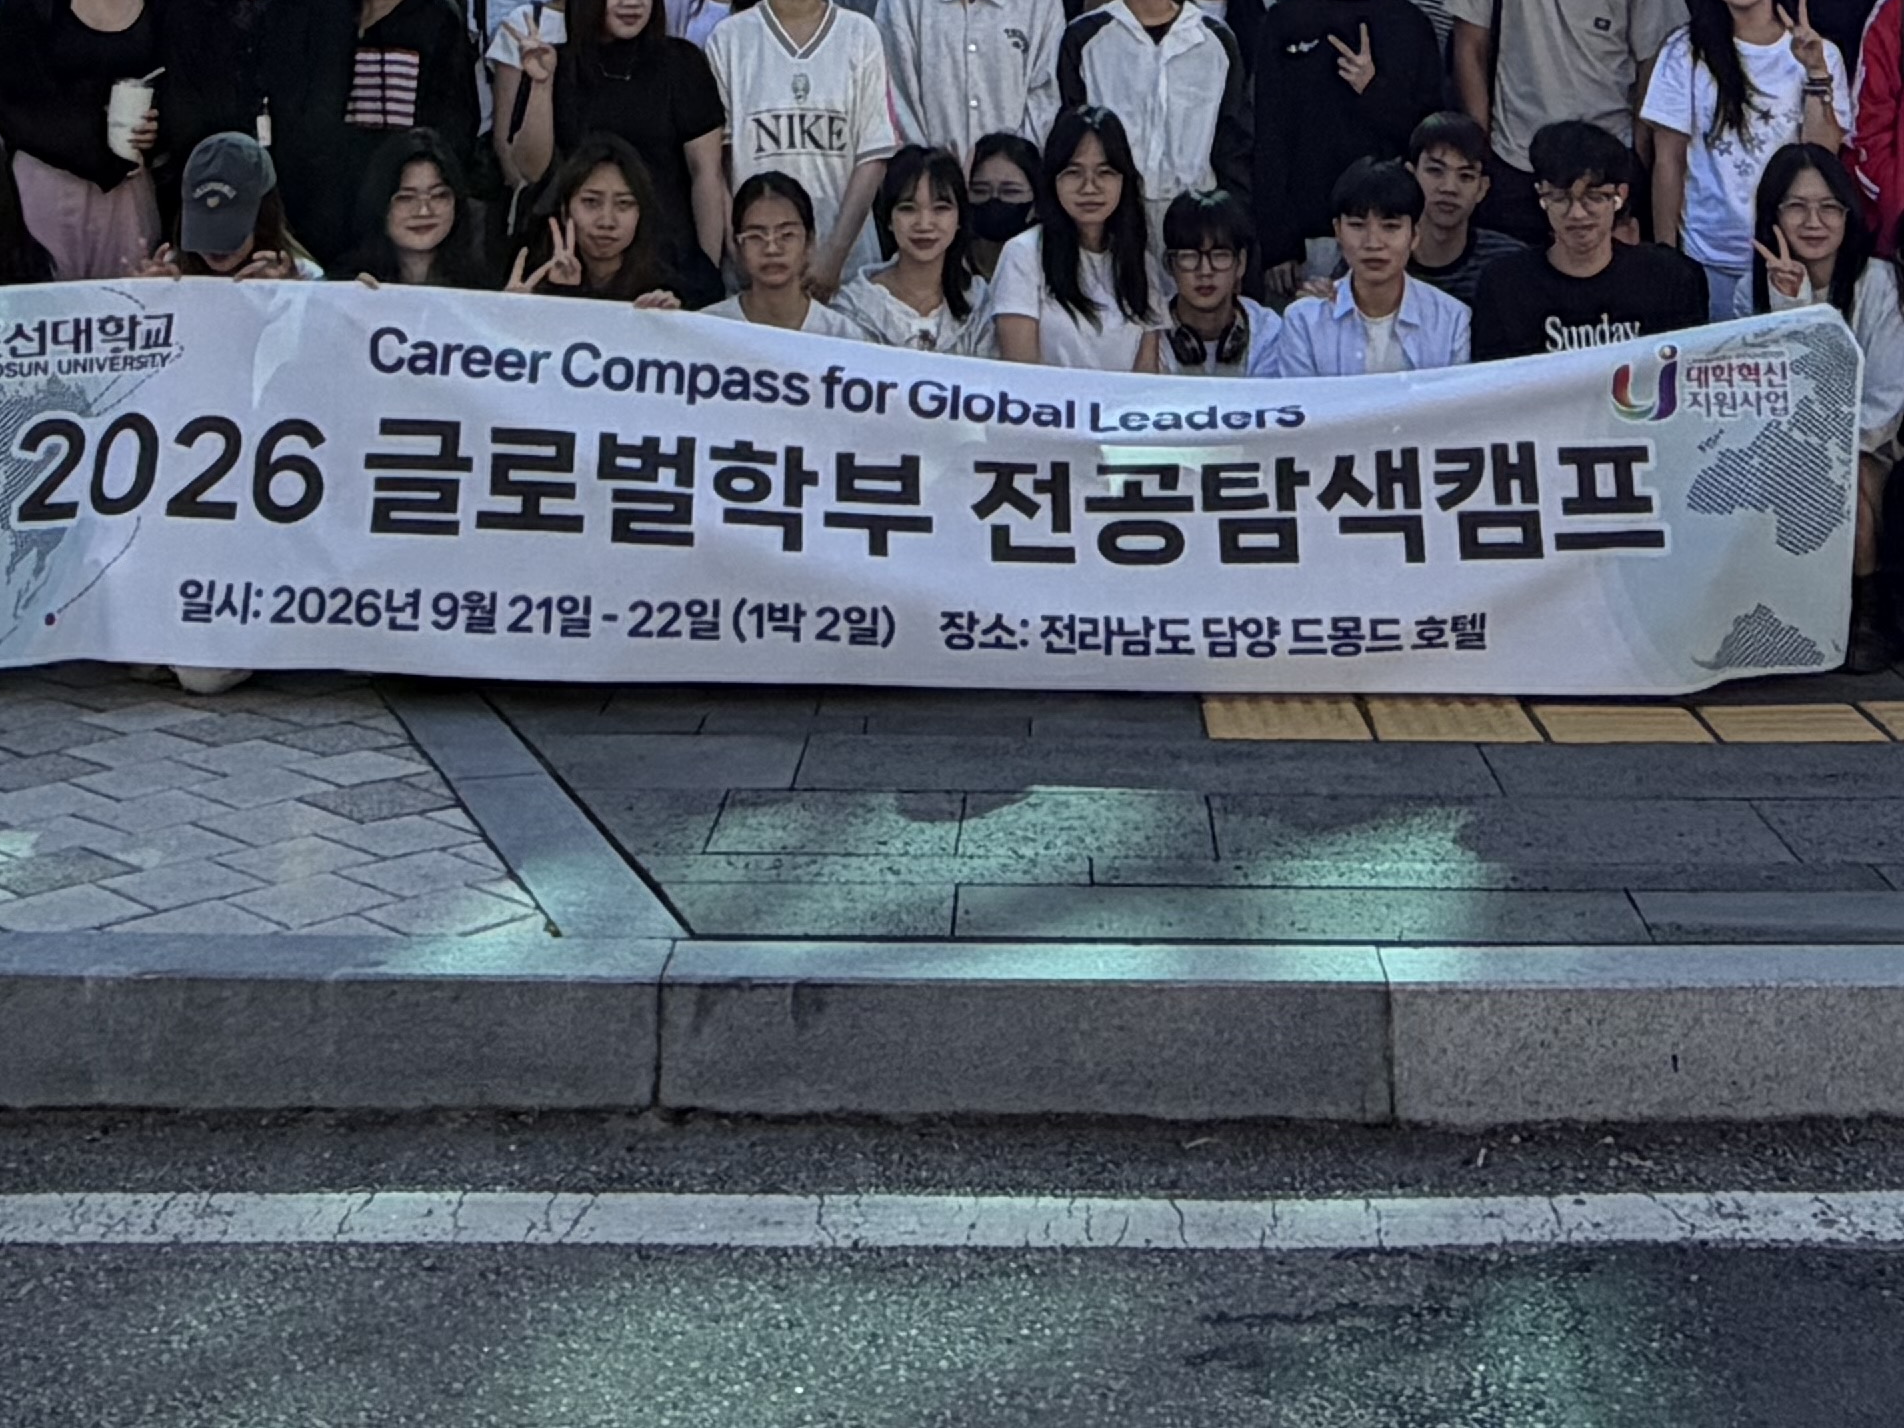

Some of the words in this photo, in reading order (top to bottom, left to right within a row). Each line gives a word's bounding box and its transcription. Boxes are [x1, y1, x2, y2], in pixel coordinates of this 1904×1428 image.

[751, 114, 848, 154] NIKE
[57, 351, 172, 377] UNIVERSITY
[369, 326, 551, 384] Career
[561, 342, 811, 406] Compass
[823, 364, 899, 414] for
[908, 379, 1076, 430] Global
[1089, 401, 1307, 434] Leaders
[1685, 360, 1789, 389] 대학혁신
[1687, 390, 1789, 418] 지원사업
[17, 412, 327, 524] 2026
[364, 417, 934, 557] 글로벌학부
[970, 440, 1665, 565] 전공탐색캠프
[430, 590, 497, 635] 9월
[732, 597, 807, 644] (1박
[814, 604, 897, 649] 2일)
[938, 610, 1030, 650] 장소:
[1039, 614, 1196, 657] 전라남도
[1201, 614, 1281, 659] 담양
[1288, 614, 1404, 658] 드몽드
[1411, 611, 1488, 651] 호텔
